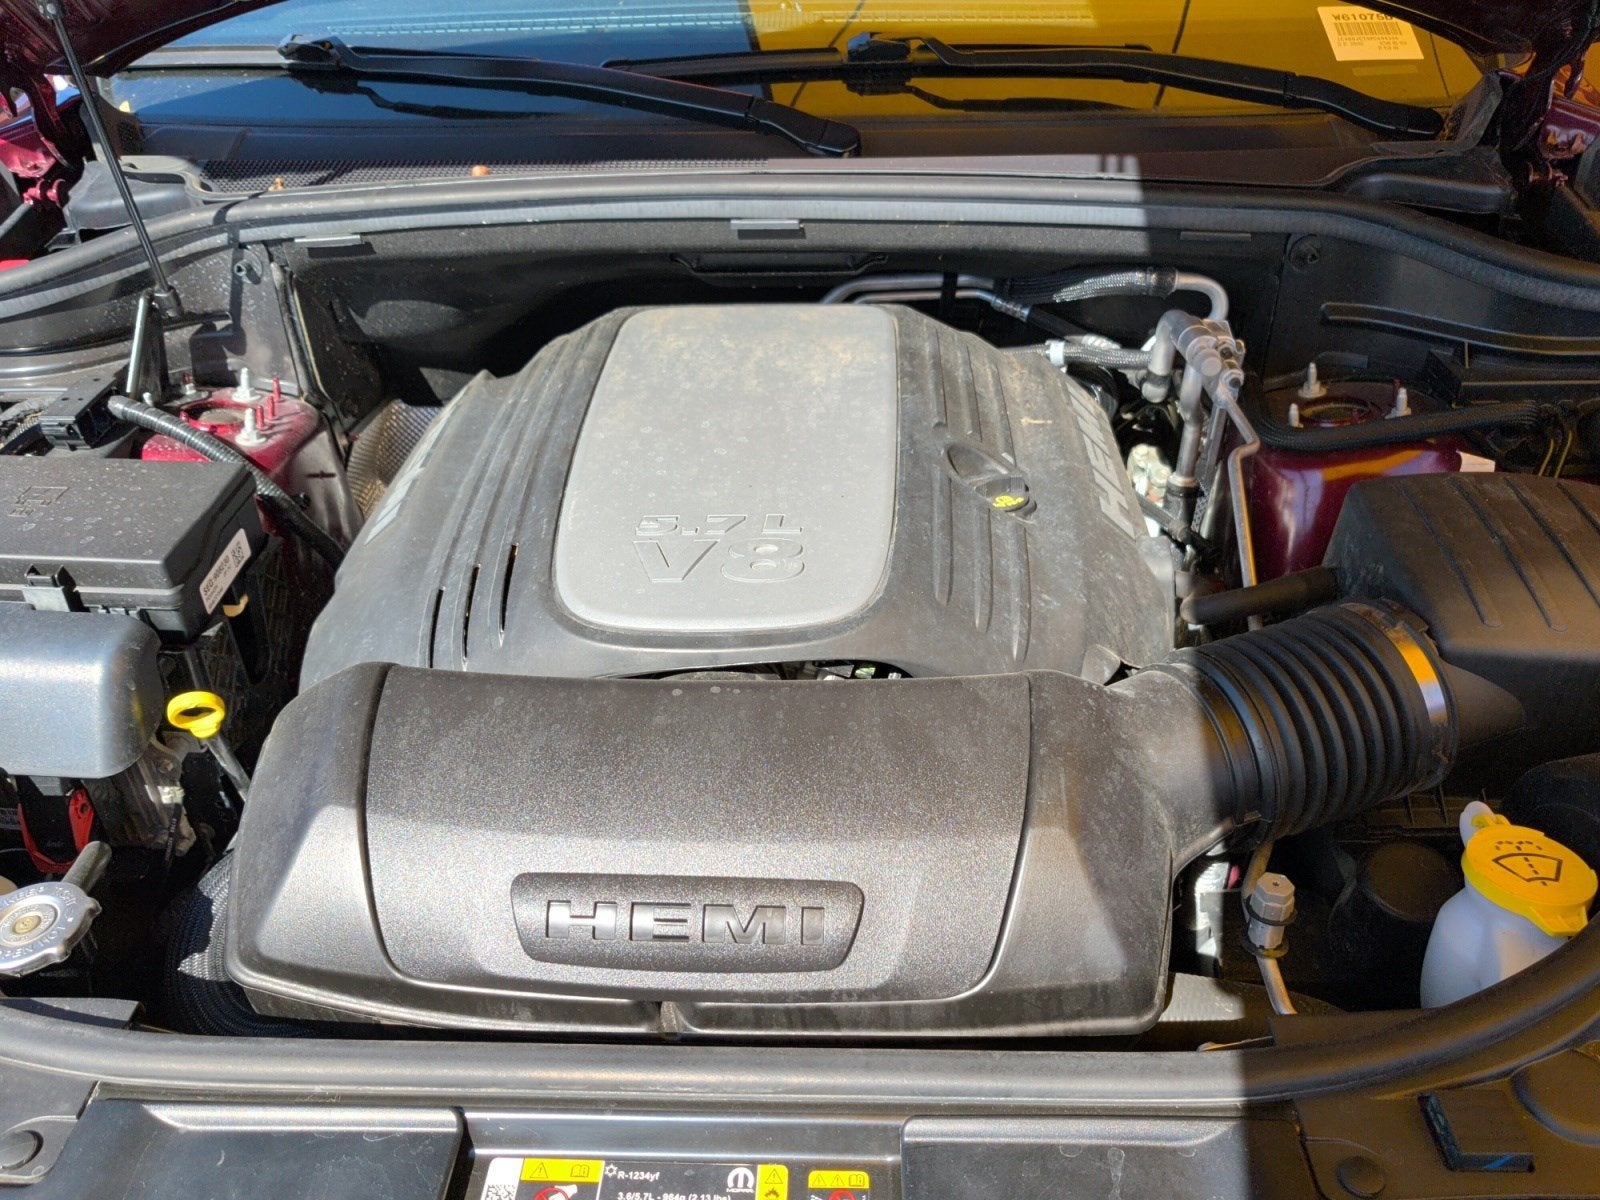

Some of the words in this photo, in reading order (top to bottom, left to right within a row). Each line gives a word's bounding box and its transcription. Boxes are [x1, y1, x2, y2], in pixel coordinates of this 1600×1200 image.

[632, 537, 806, 583] V8
[545, 899, 826, 946] HEMI
[617, 1171, 660, 1182] R-1234yf
